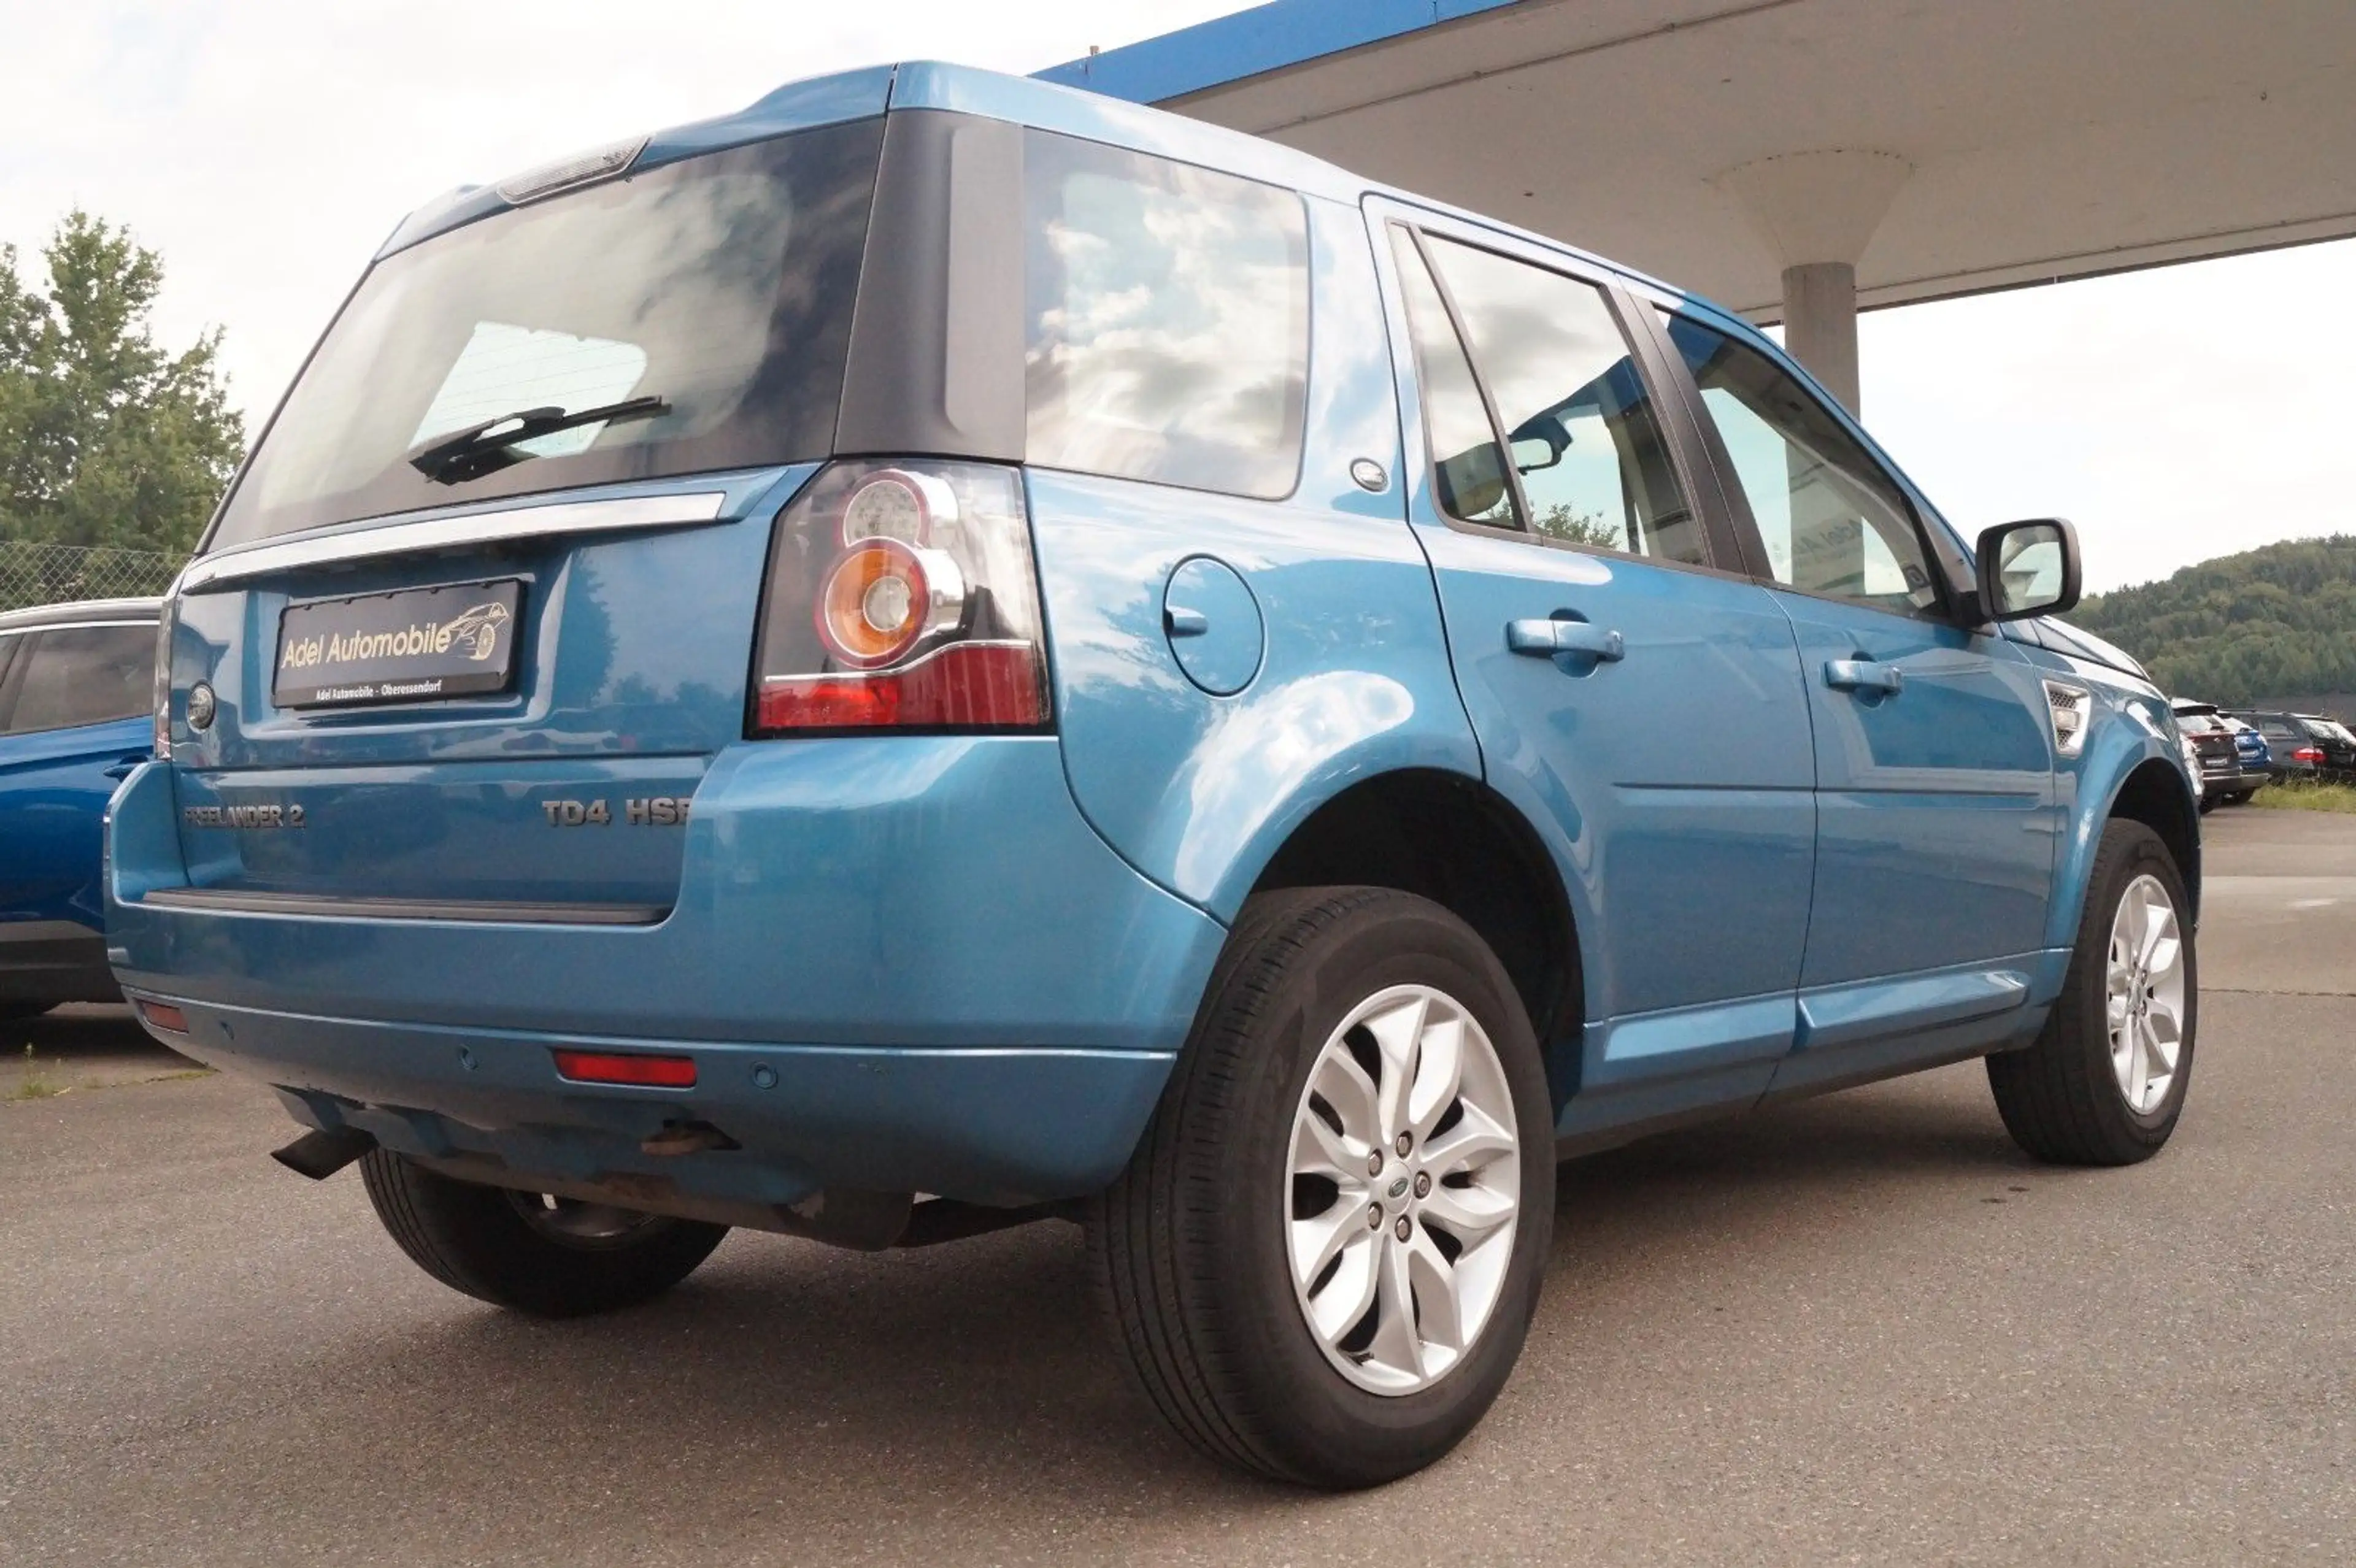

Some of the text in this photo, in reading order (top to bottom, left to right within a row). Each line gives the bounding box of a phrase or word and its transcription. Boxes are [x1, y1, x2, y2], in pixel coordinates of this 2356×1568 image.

[281, 623, 452, 668] Adel Automobile
[316, 690, 331, 701] Adel
[332, 685, 374, 699] Automobile
[290, 804, 305, 827] 2
[542, 799, 610, 826] TD4
